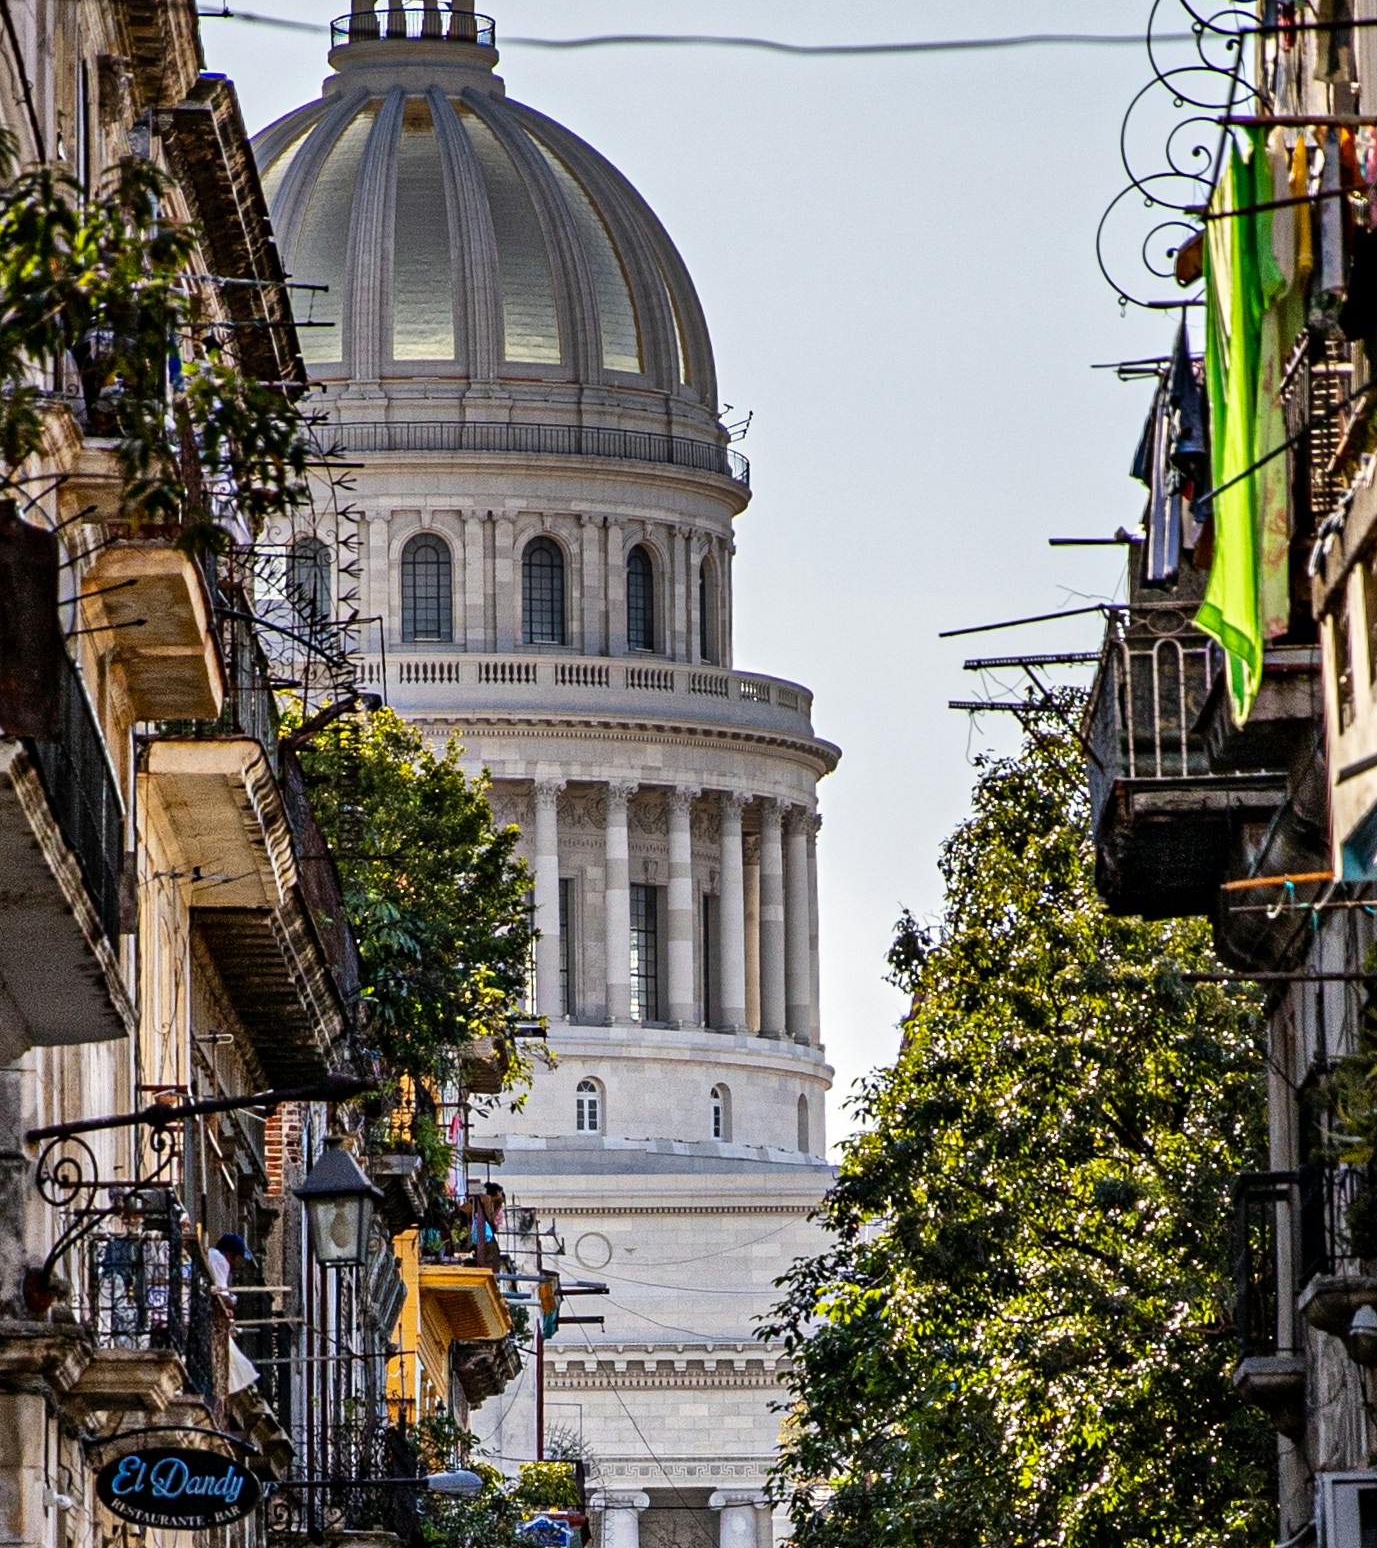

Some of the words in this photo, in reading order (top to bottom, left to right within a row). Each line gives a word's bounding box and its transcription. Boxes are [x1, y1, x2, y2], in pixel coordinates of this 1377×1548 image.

[111, 1455, 148, 1496] El
[149, 1457, 245, 1503] Dandy
[110, 1497, 205, 1527] RESTAURANTE
[214, 1504, 242, 1524] BAR
